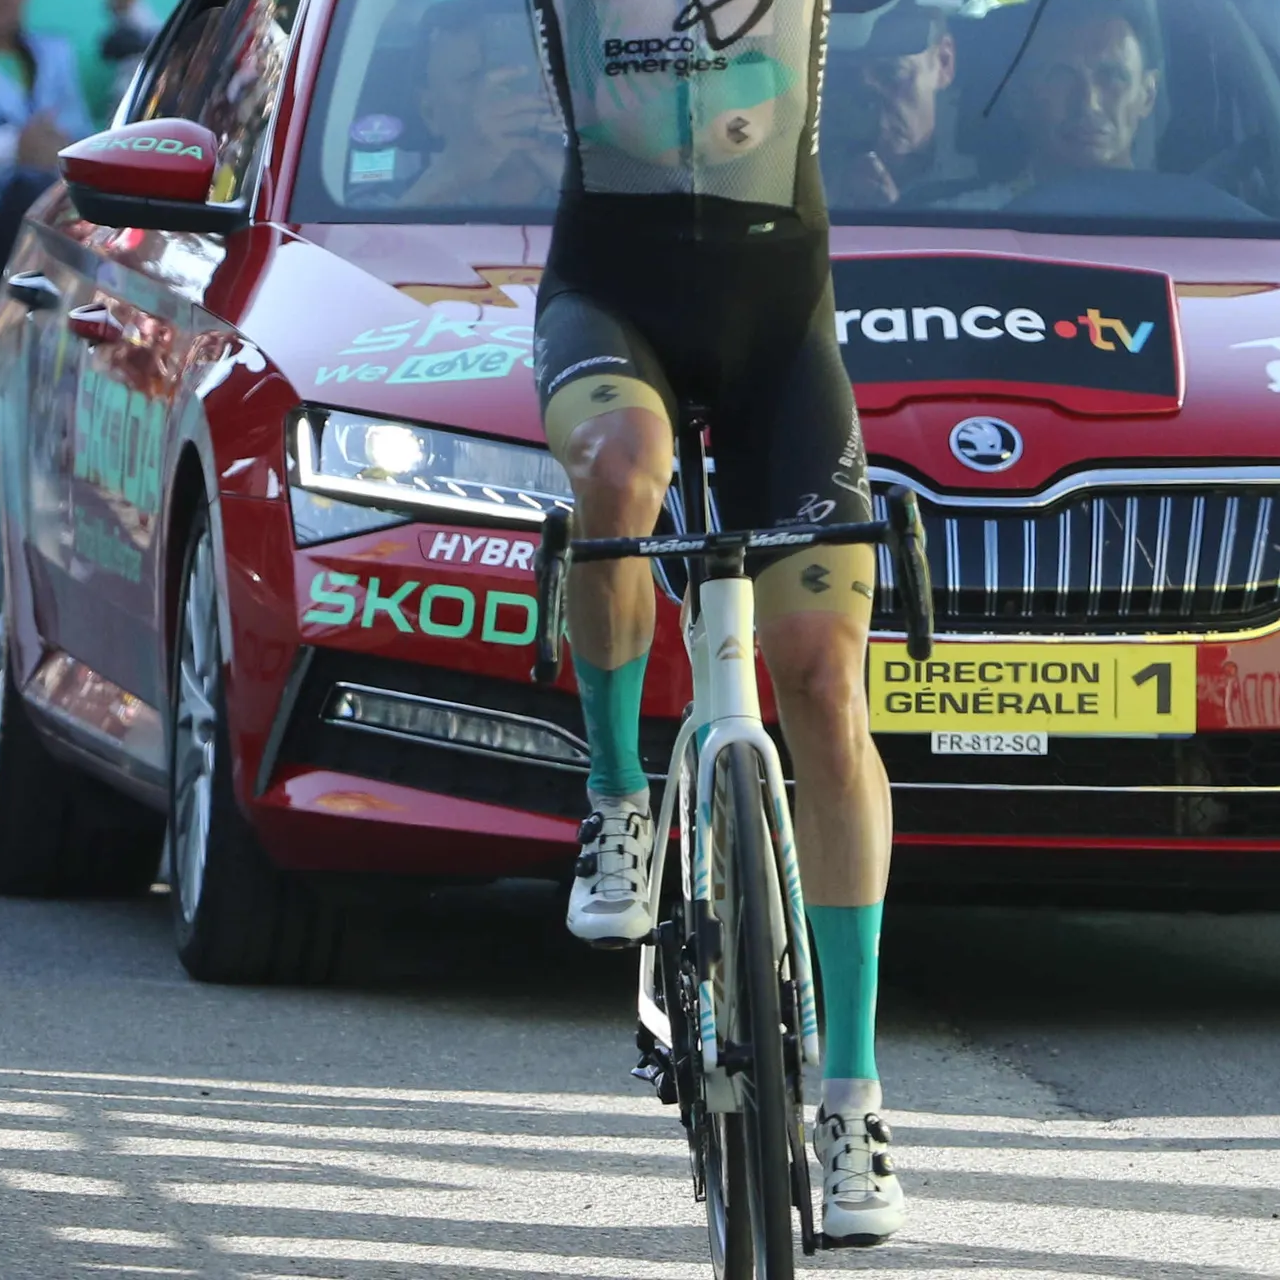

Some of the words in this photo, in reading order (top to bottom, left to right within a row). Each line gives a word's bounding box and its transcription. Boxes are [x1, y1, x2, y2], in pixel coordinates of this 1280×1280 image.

[605, 37, 695, 58] Bapco
[605, 55, 729, 78] energies
[428, 531, 537, 572] HYBR
[304, 572, 571, 646] SKOD
[884, 661, 1100, 683] DIRECTION
[884, 687, 1100, 714] GÉNÉRALE
[1131, 662, 1172, 714] 1
[936, 734, 1042, 754] FR-812-SQ
